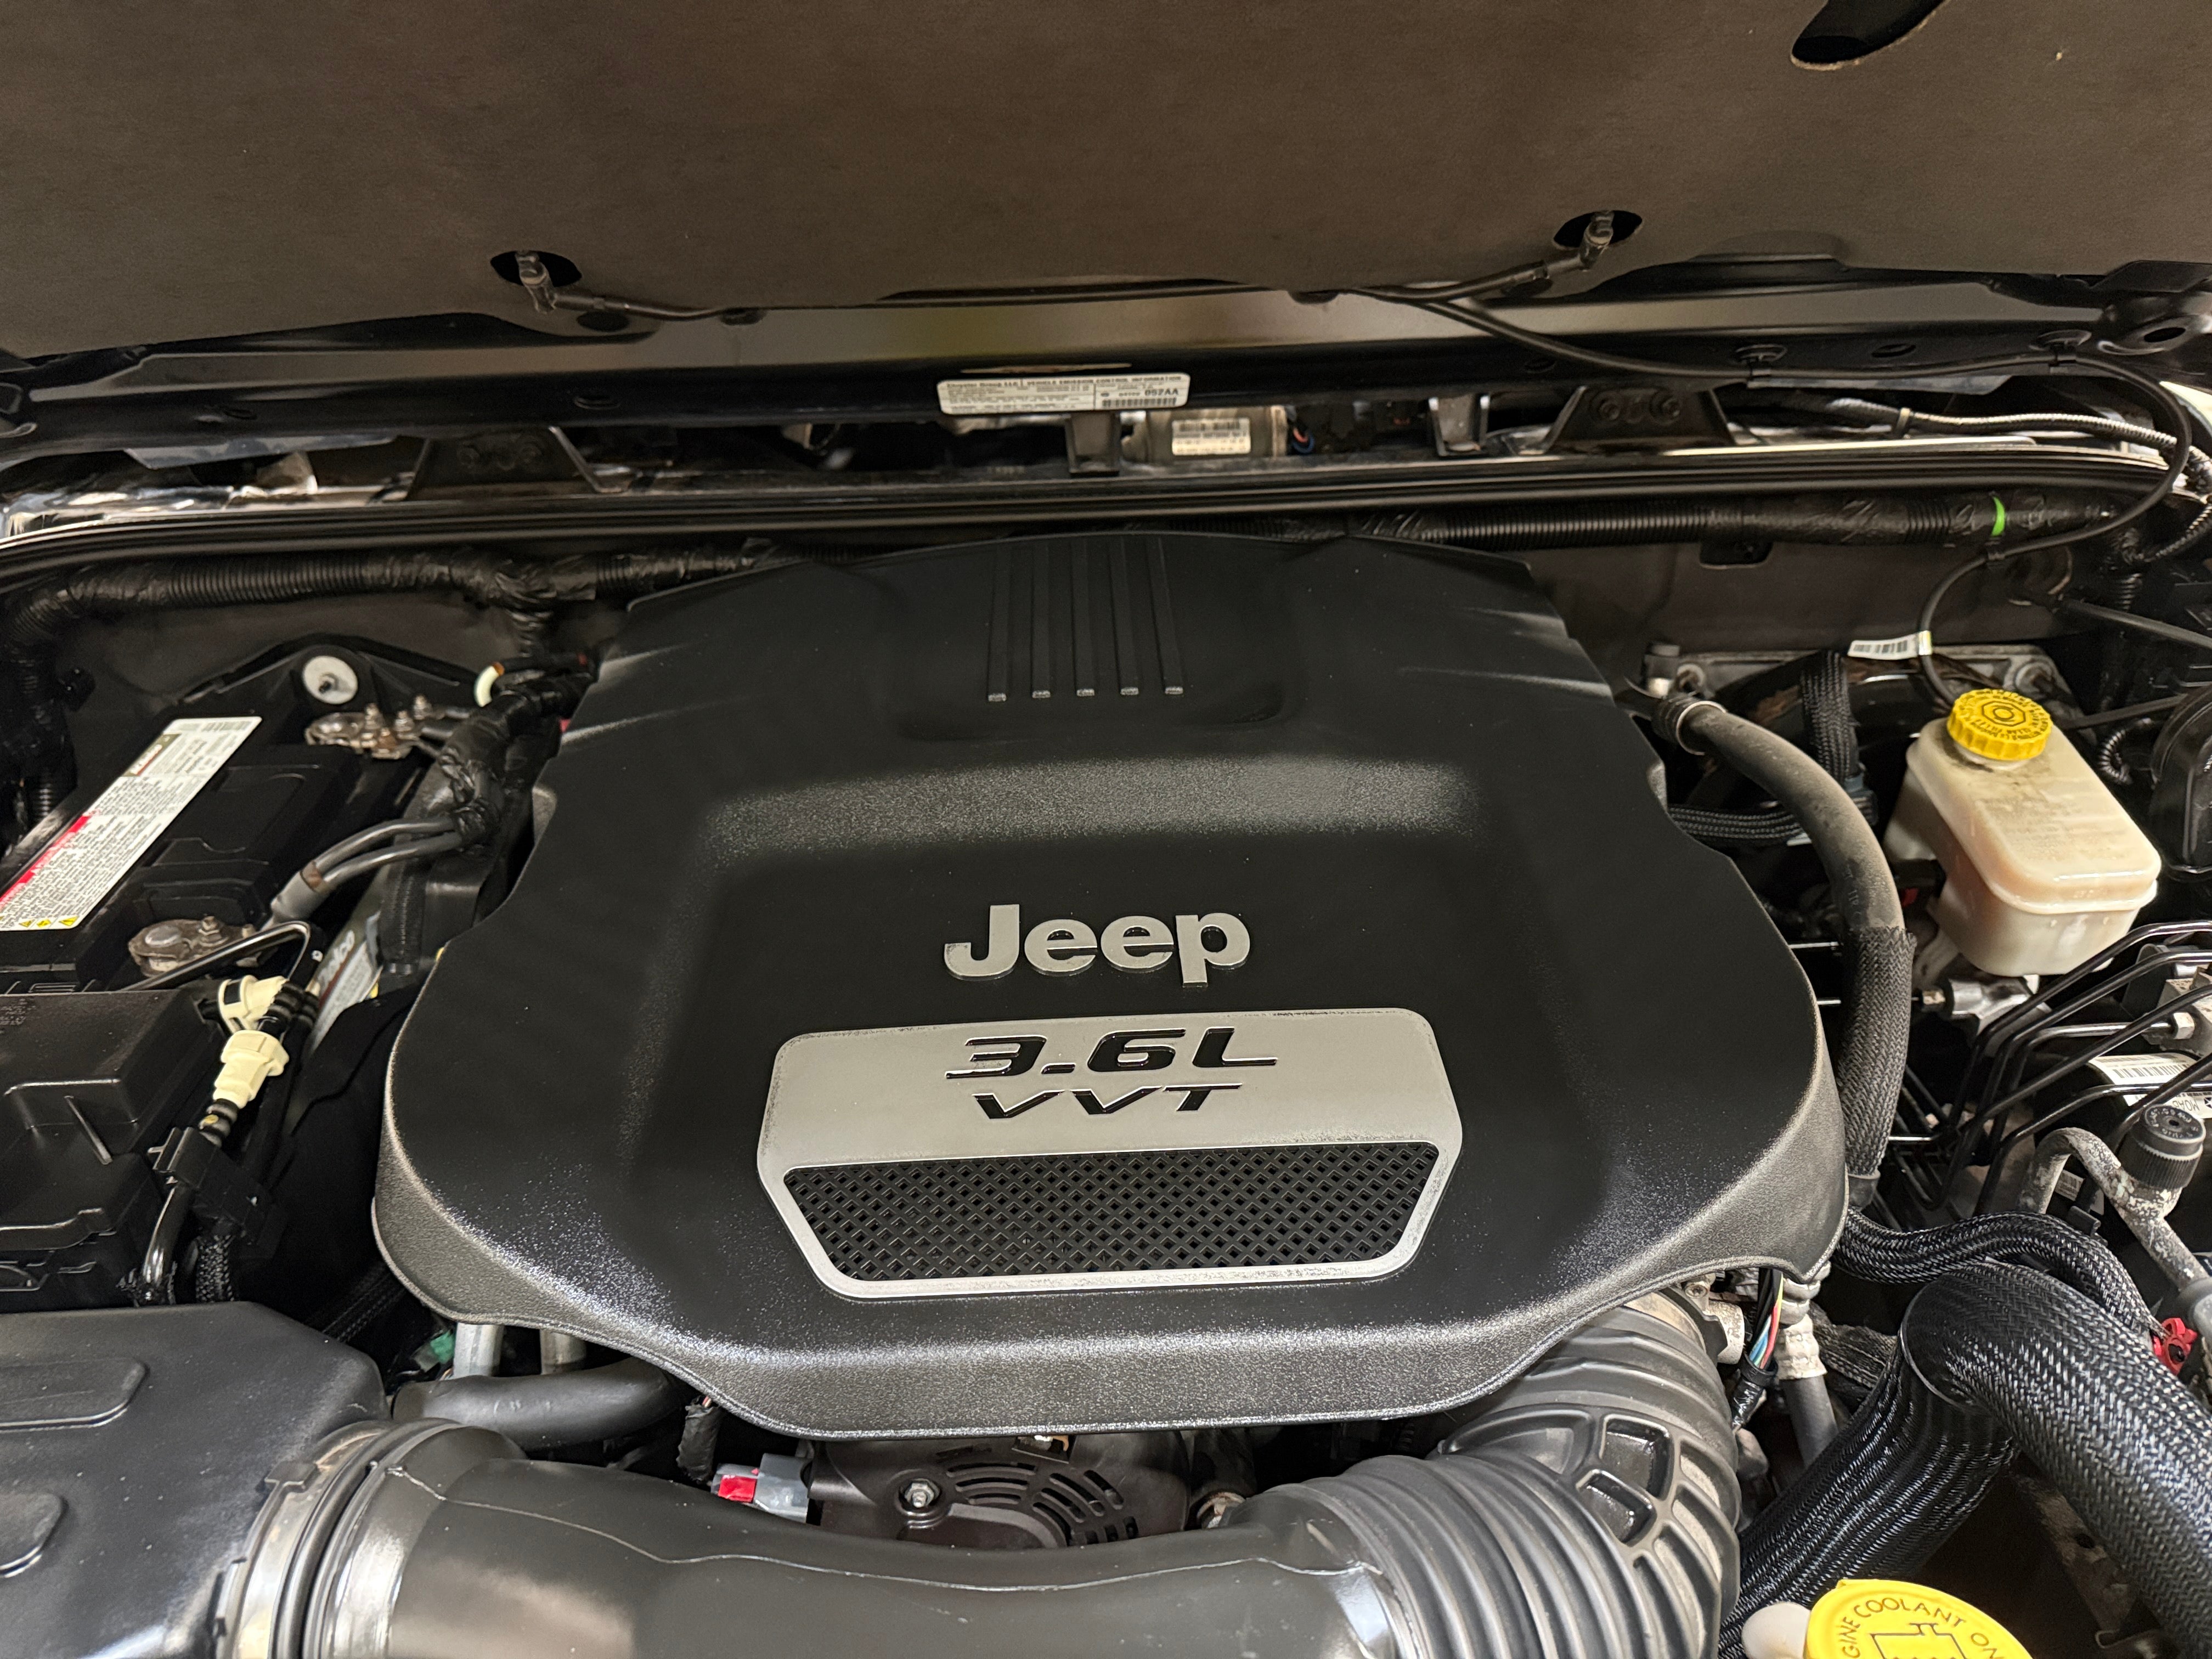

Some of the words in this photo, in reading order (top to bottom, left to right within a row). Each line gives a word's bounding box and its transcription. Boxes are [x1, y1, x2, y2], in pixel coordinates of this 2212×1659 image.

[944, 904, 1250, 987] Jeep
[945, 1026, 1278, 1079] 3.6L
[972, 1083, 1243, 1119] VVT
[1854, 1597, 1967, 1628] COOLANT
